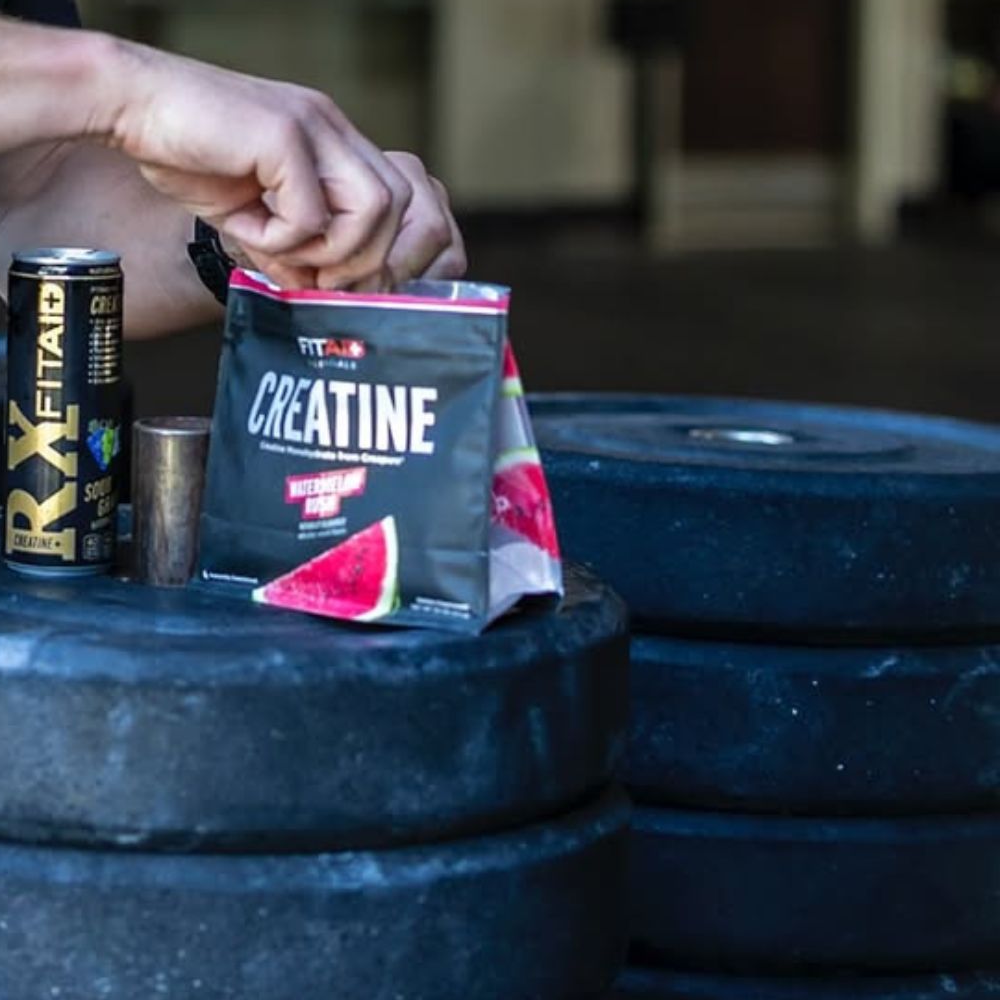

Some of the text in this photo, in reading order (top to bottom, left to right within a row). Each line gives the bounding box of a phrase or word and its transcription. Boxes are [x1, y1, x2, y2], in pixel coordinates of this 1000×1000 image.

[35, 281, 65, 418] FITAID
[248, 371, 438, 455] CREATINE
[6, 400, 80, 561] RX
